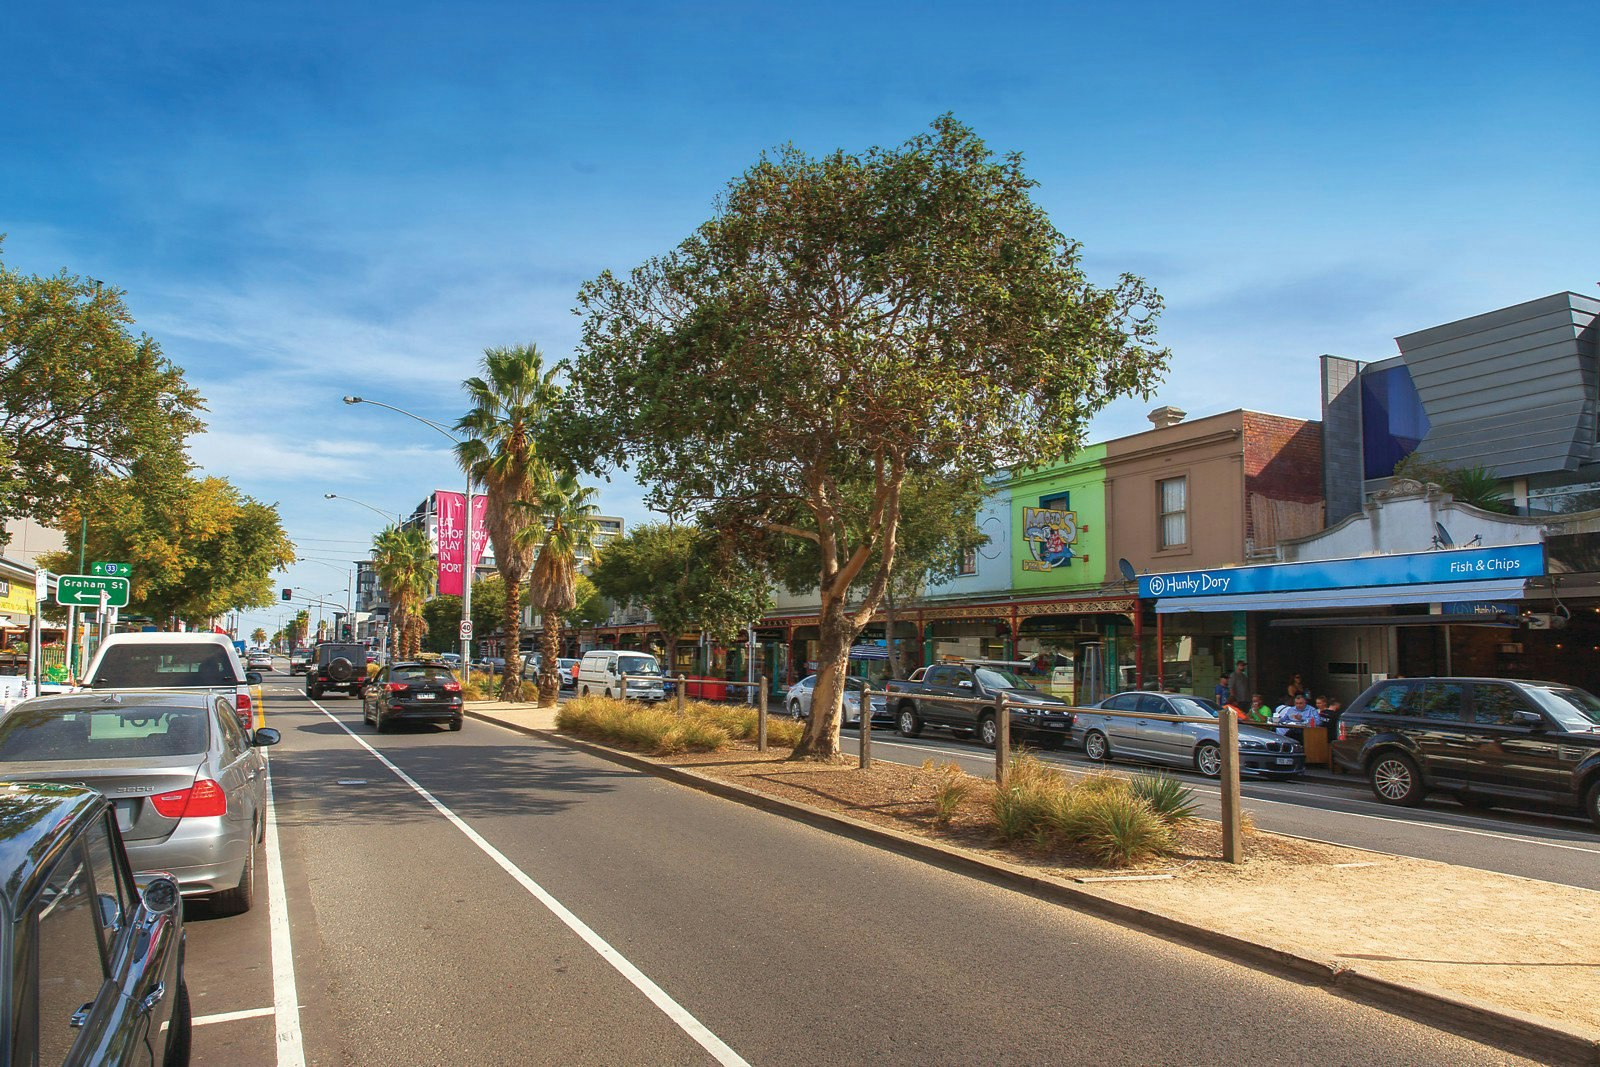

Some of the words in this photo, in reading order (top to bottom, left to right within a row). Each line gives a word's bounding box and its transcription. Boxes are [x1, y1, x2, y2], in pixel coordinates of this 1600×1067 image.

[440, 517, 454, 528] EAT
[440, 529, 463, 539] SHOP
[440, 540, 460, 550] PLAY
[440, 552, 451, 561] IN
[440, 562, 462, 573] PORT
[1450, 561, 1473, 573] Fish
[1475, 560, 1485, 571] &
[1487, 557, 1520, 571] Chips
[63, 579, 106, 589] Graham
[111, 581, 124, 590] St
[1166, 575, 1200, 593] Hunky
[1202, 573, 1231, 592] Dory
